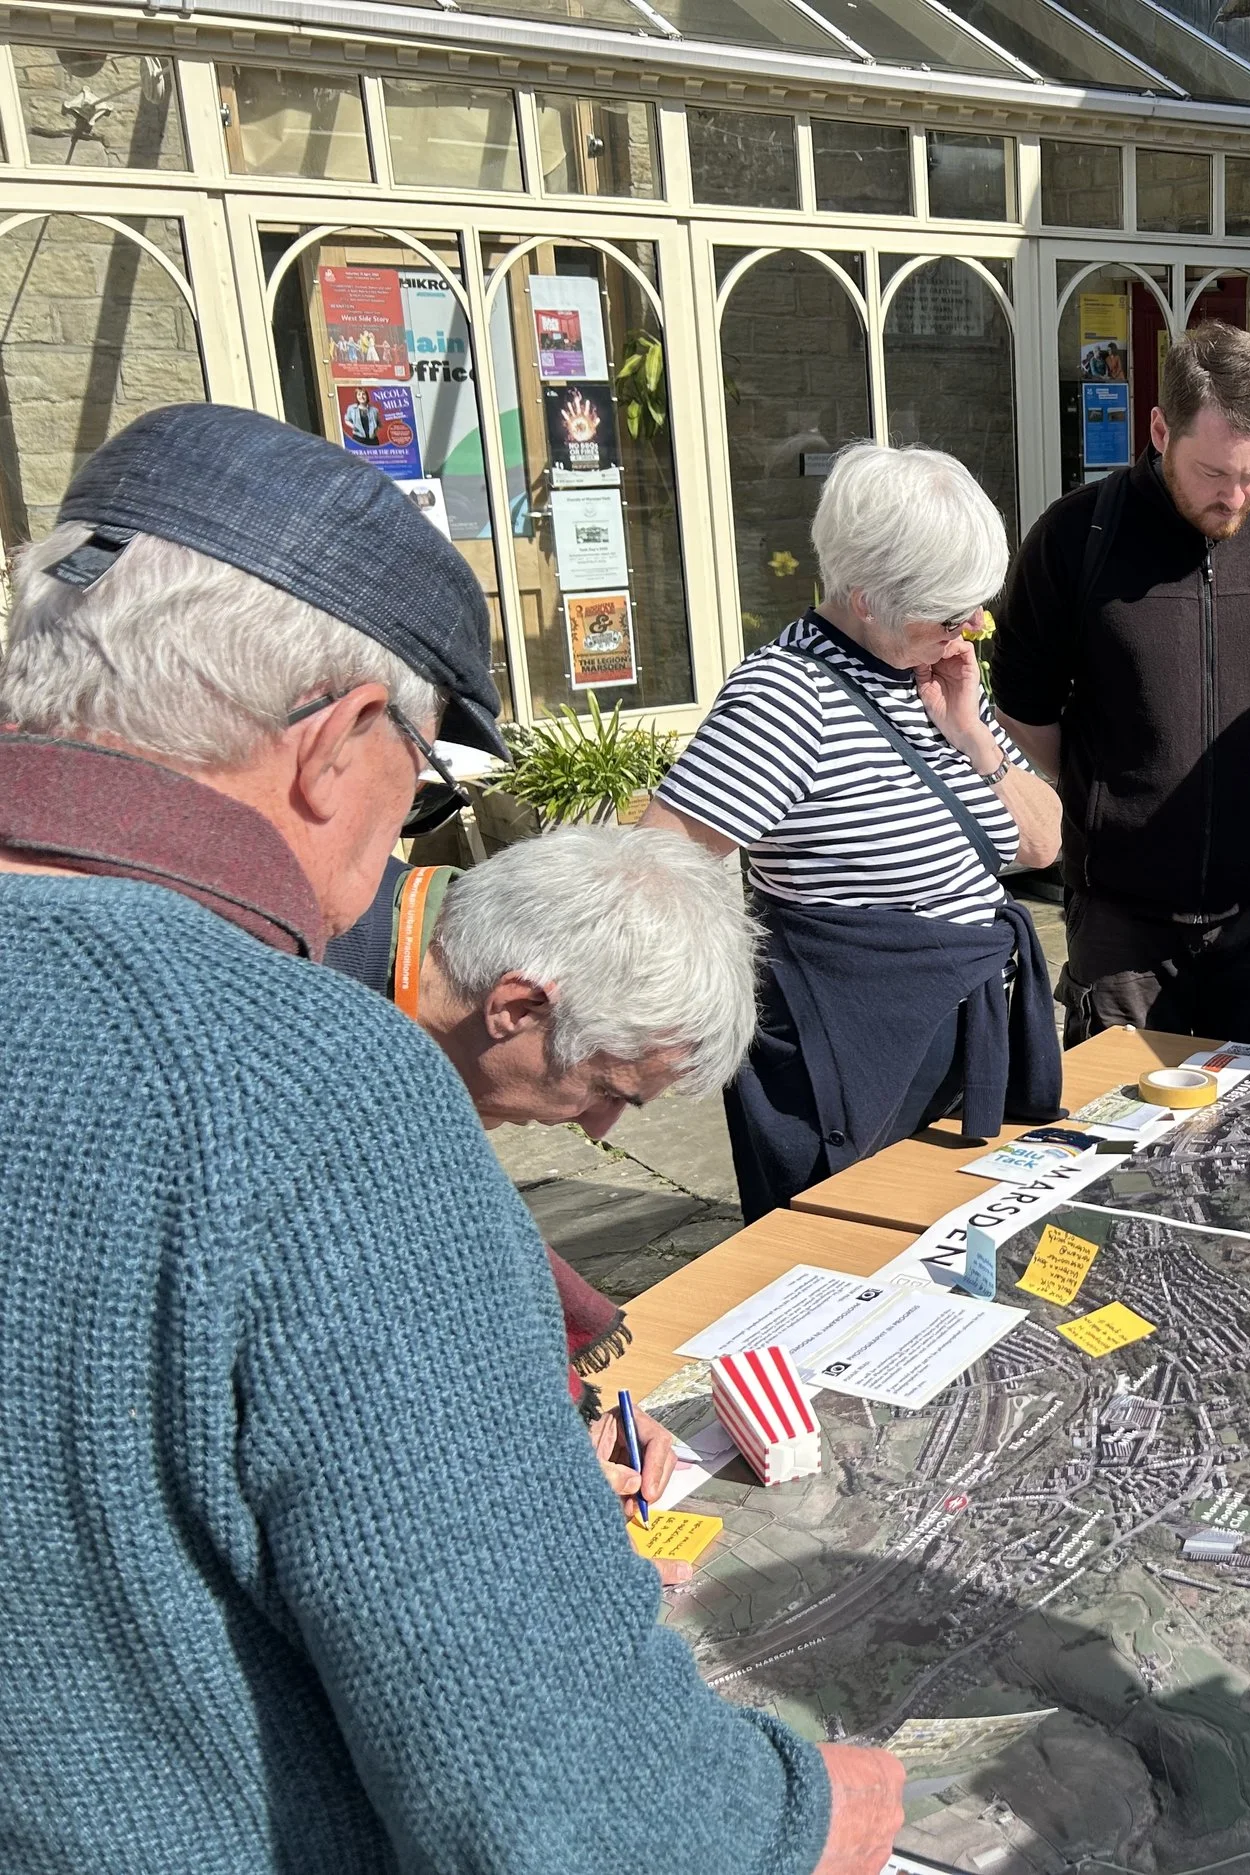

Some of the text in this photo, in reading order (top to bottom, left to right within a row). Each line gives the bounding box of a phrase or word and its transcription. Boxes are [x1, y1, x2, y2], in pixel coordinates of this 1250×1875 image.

[399, 278, 450, 290] MIKRO
[405, 329, 465, 353] lain
[373, 388, 409, 401] NICOLA
[383, 399, 410, 410] MILLS
[597, 656, 628, 665] LEGION
[994, 1154, 1039, 1169] Tack
[1012, 1148, 1045, 1161] Blu
[919, 1165, 1083, 1267] MARSDEN
[846, 1331, 887, 1360] PHOTOGRAPHY
[1009, 1399, 1065, 1451] The Goodsyard
[946, 1452, 983, 1483] National
[958, 1468, 981, 1486] Trust
[1201, 1487, 1234, 1522] Marsden
[1214, 1491, 1246, 1526] Football
[1229, 1508, 1250, 1529] Club
[896, 1510, 942, 1552] MARSDEN
[915, 1513, 956, 1550] STATION
[1063, 1538, 1095, 1569] Church
[706, 1636, 827, 1689] DERSFIELD NARROW CANAL
